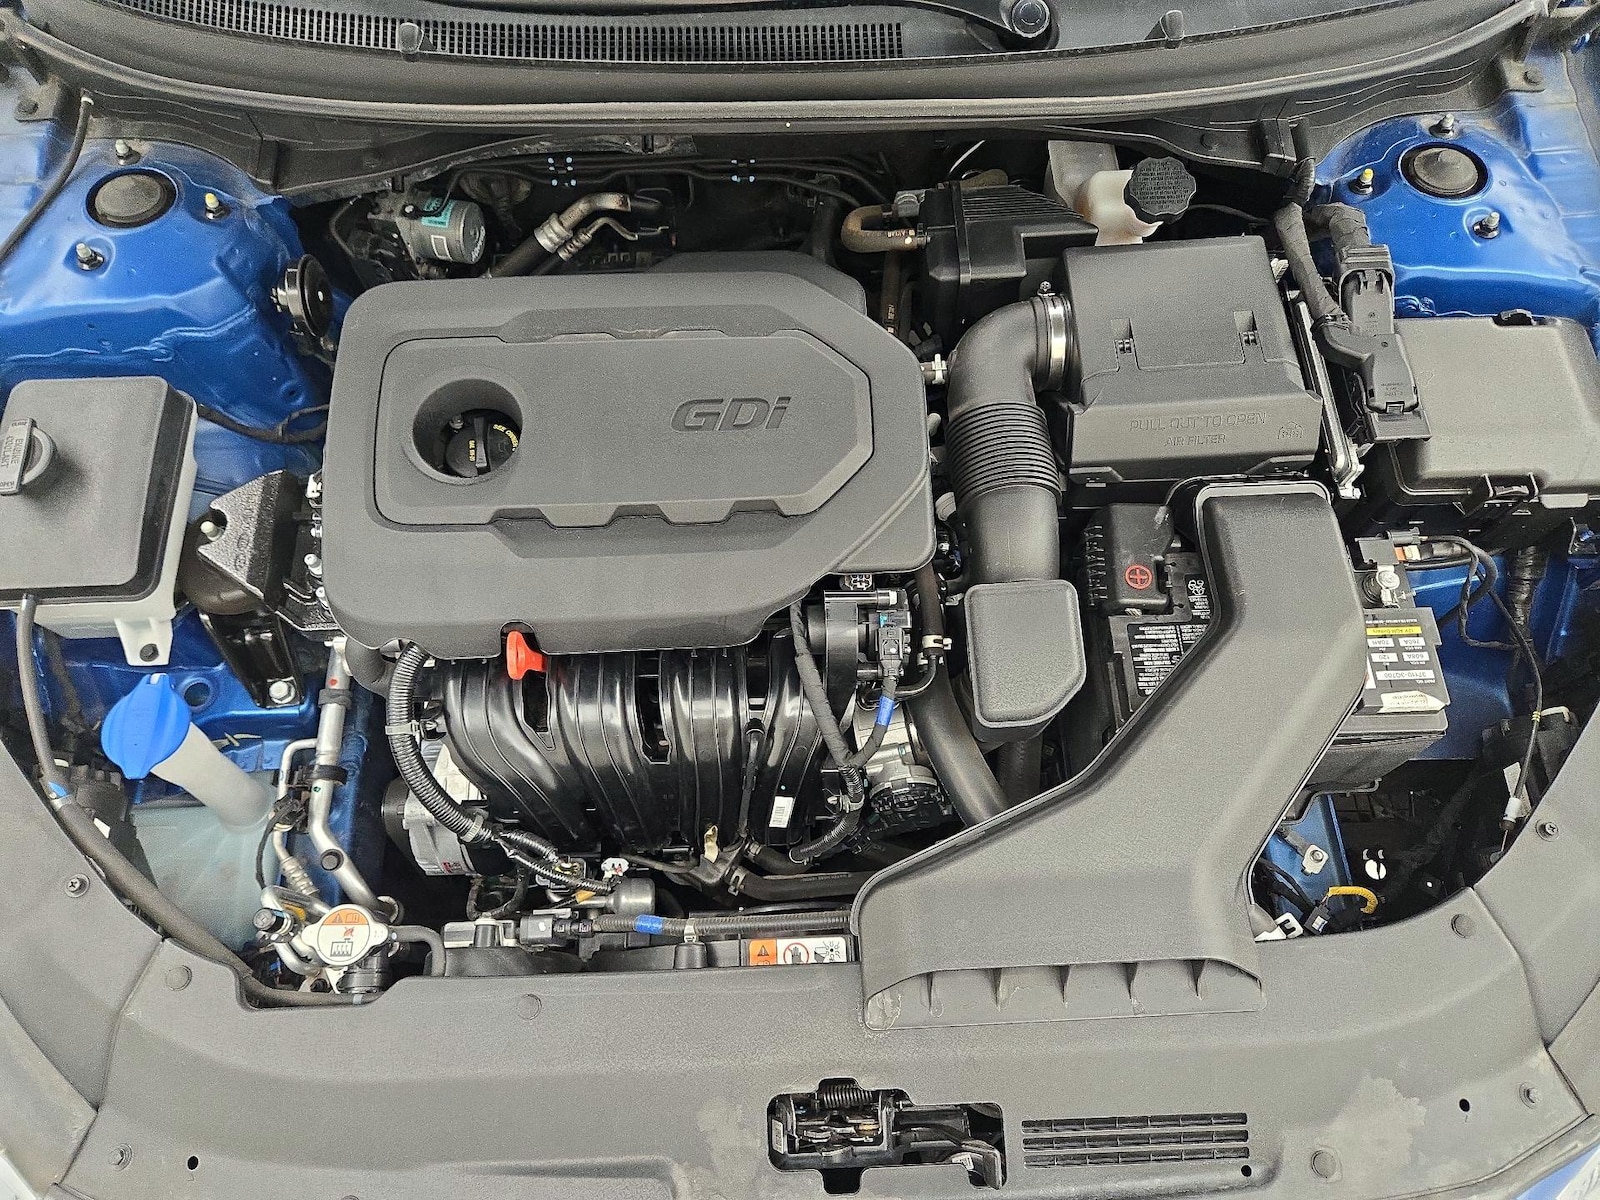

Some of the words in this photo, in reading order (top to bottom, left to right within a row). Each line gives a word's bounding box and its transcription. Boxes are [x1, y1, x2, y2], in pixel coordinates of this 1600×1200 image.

[671, 396, 791, 432] GDi
[1129, 418, 1166, 431] PULL
[1170, 416, 1198, 430] OUT
[1202, 415, 1222, 428] TO
[1226, 412, 1267, 427] OPEN
[1, 435, 14, 468] COOLANT
[11, 438, 24, 465] ENGINE
[1164, 436, 1185, 447] AIR
[1187, 434, 1227, 446] FILTER
